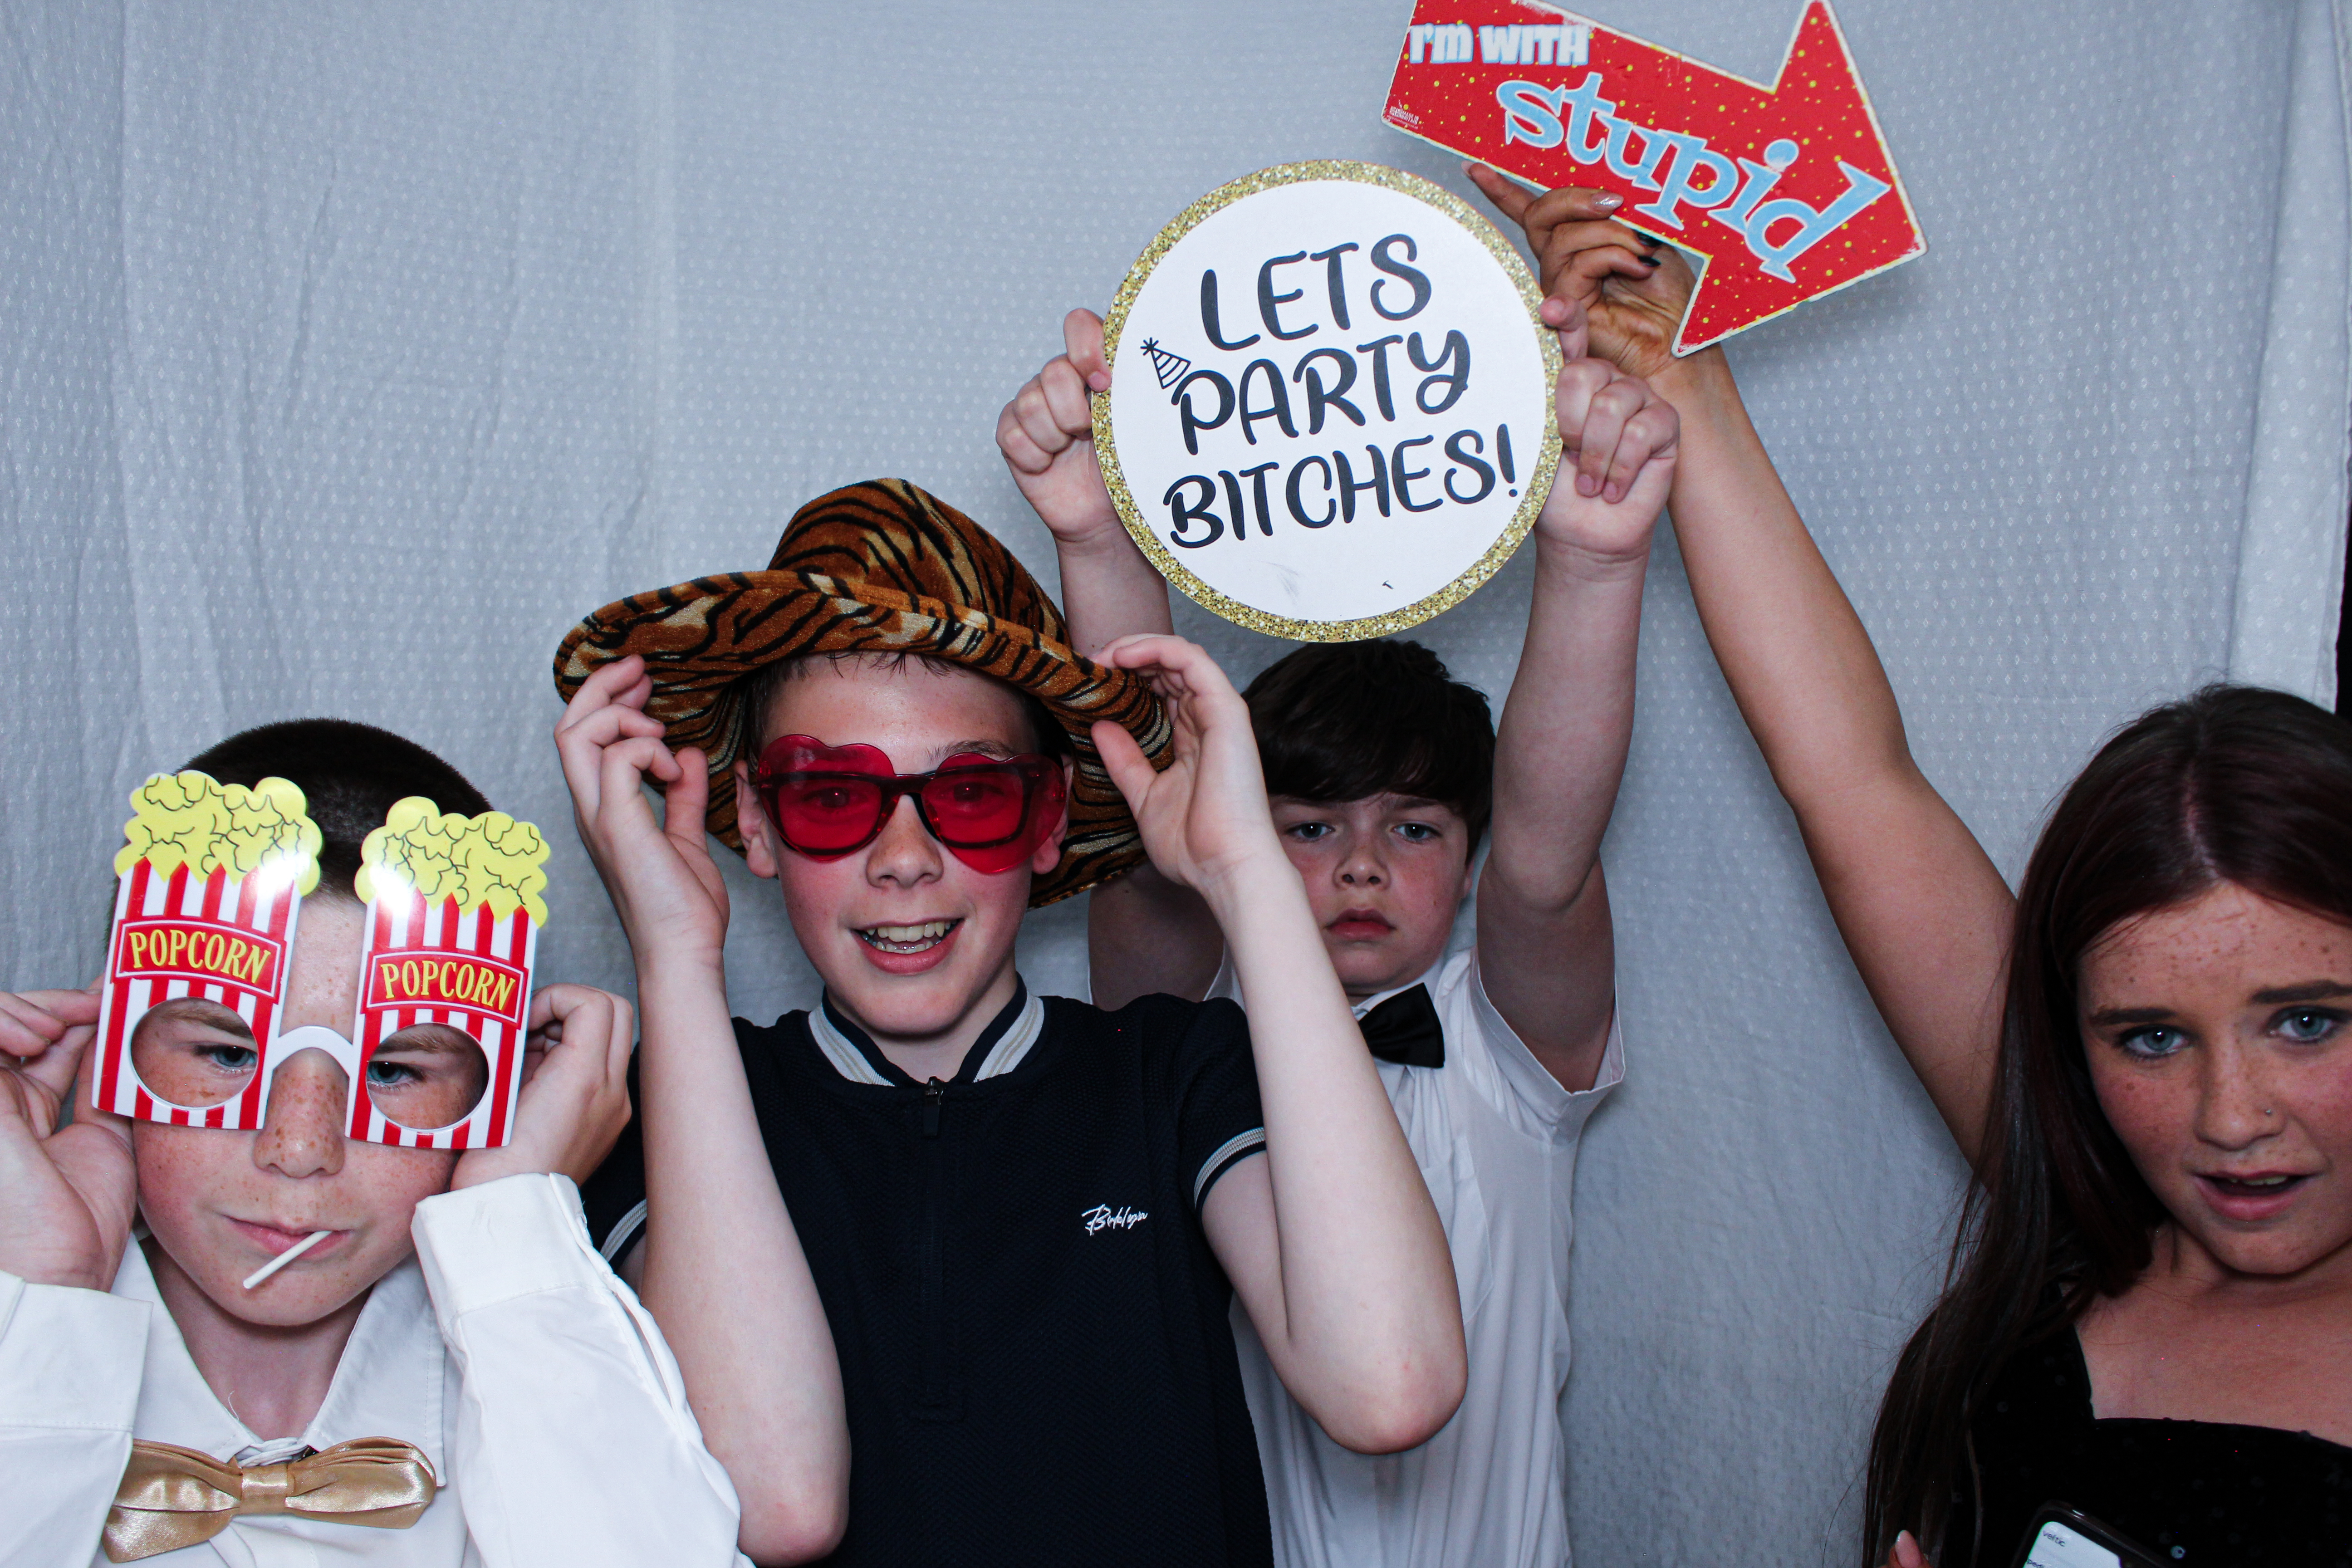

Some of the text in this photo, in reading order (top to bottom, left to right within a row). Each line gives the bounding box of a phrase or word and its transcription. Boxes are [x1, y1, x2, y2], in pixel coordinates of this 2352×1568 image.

[1478, 24, 1589, 66] WITH
[1496, 71, 1891, 283] stupid
[1200, 234, 1432, 351] LETS
[1171, 329, 1471, 456] PARTY
[1162, 423, 1518, 549] BITCHES!
[128, 928, 272, 985] POPCORN
[380, 959, 516, 1011] POPCORN
